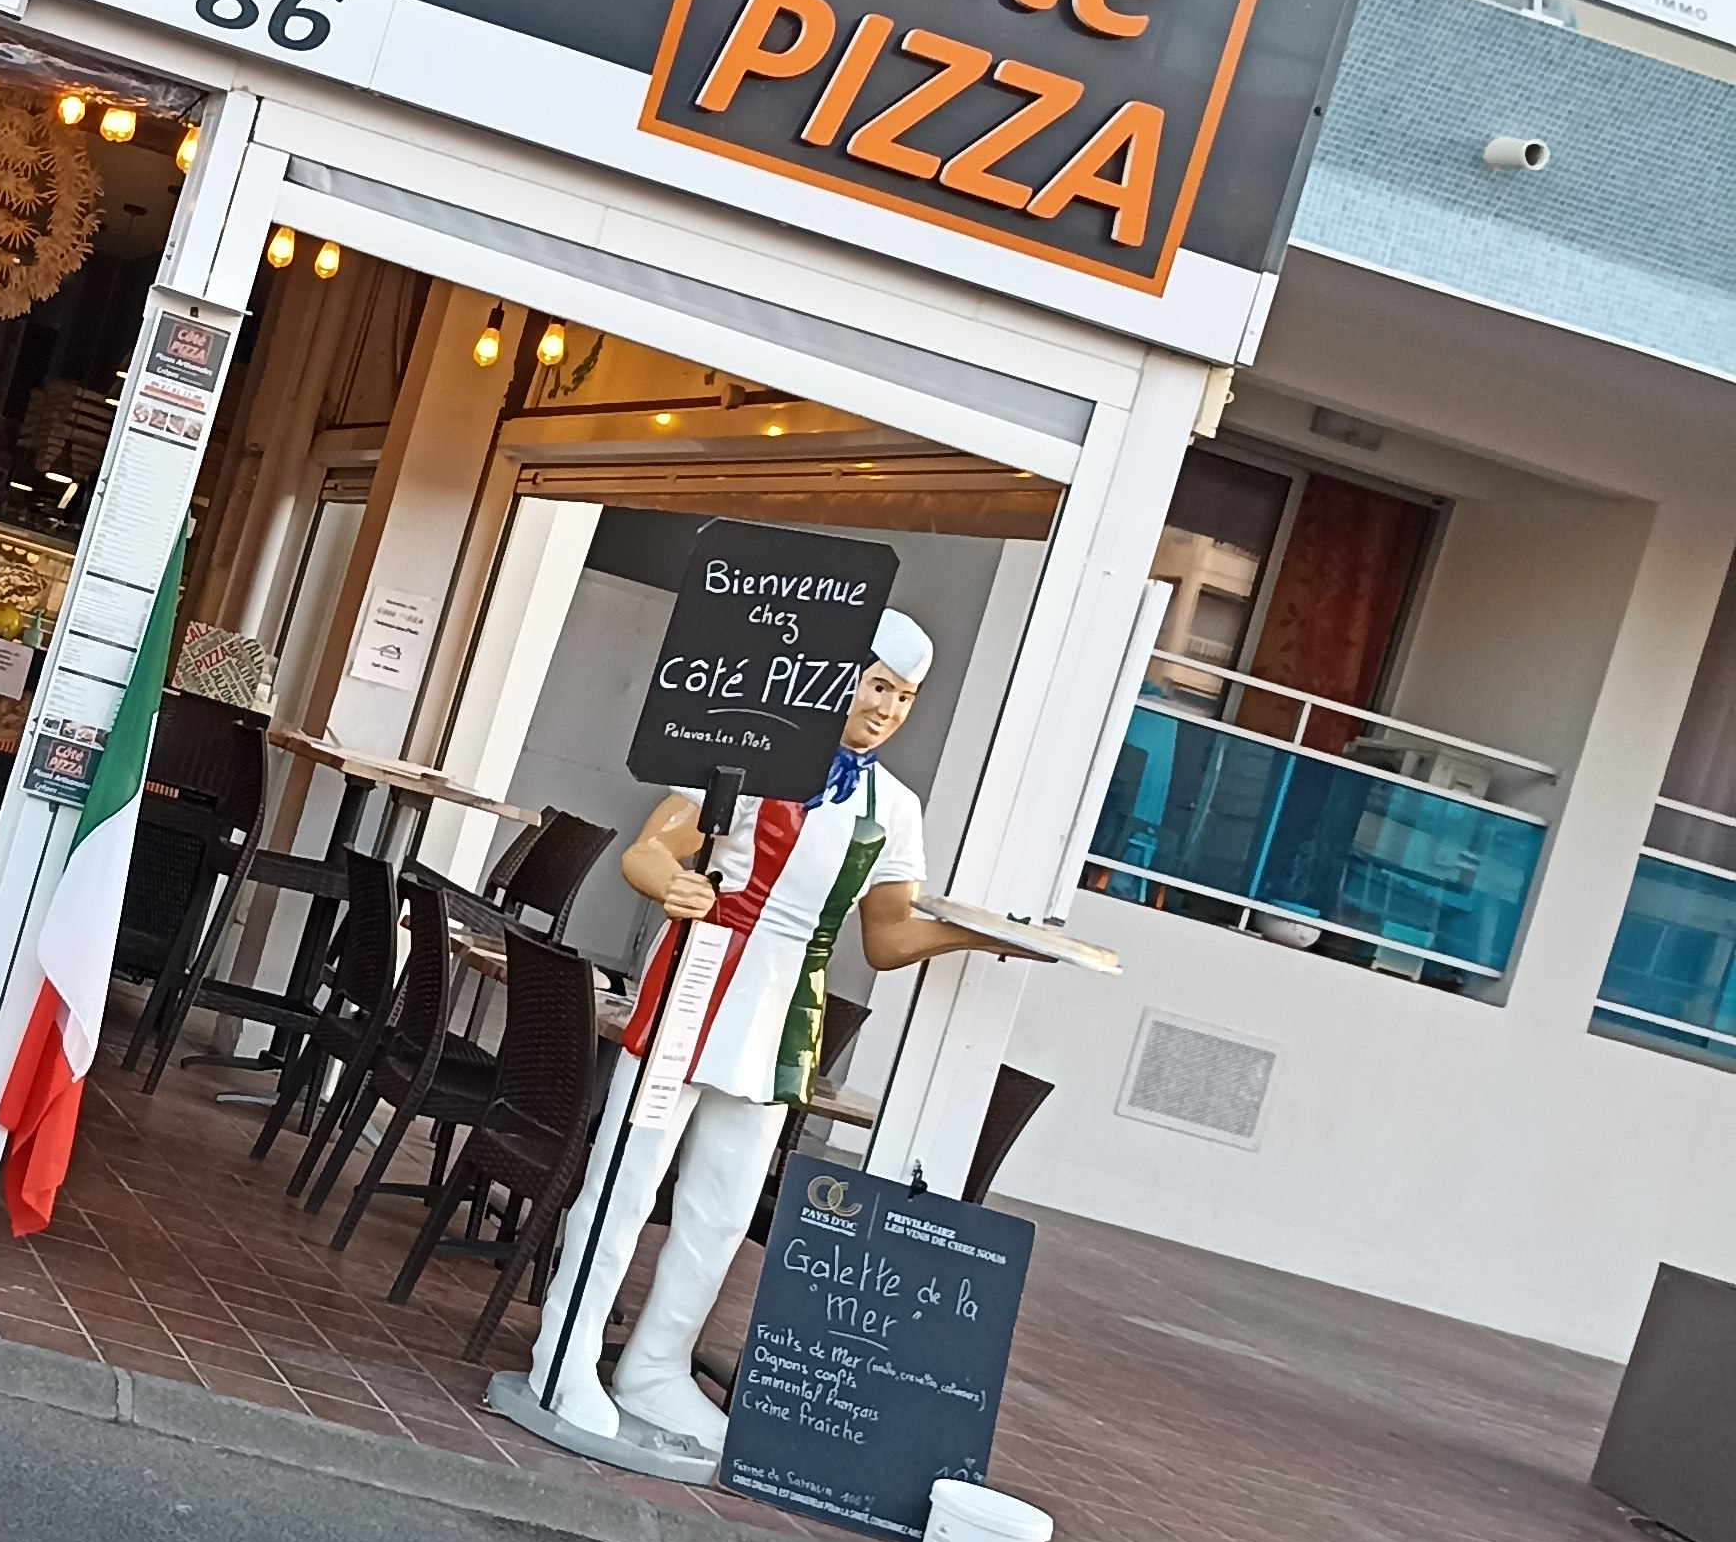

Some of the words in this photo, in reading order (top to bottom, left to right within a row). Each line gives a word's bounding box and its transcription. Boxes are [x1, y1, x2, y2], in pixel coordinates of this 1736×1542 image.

[704, 559, 868, 607] Bienvenue
[748, 603, 800, 644] chez
[193, 644, 231, 674] PIZZA
[659, 656, 749, 698] Côté
[761, 653, 862, 716] PIZZA
[801, 1206, 831, 1225] PAYS
[783, 1238, 901, 1297] Galette
[916, 1276, 942, 1306] de
[955, 1278, 979, 1322] la
[754, 1345, 809, 1374] Oignons
[756, 1324, 802, 1352] Fruits
[809, 1340, 826, 1360] de
[748, 1368, 823, 1402] Emmental
[825, 1386, 880, 1421] français
[742, 1391, 792, 1421] Crème
[798, 1401, 865, 1444] fraîche
